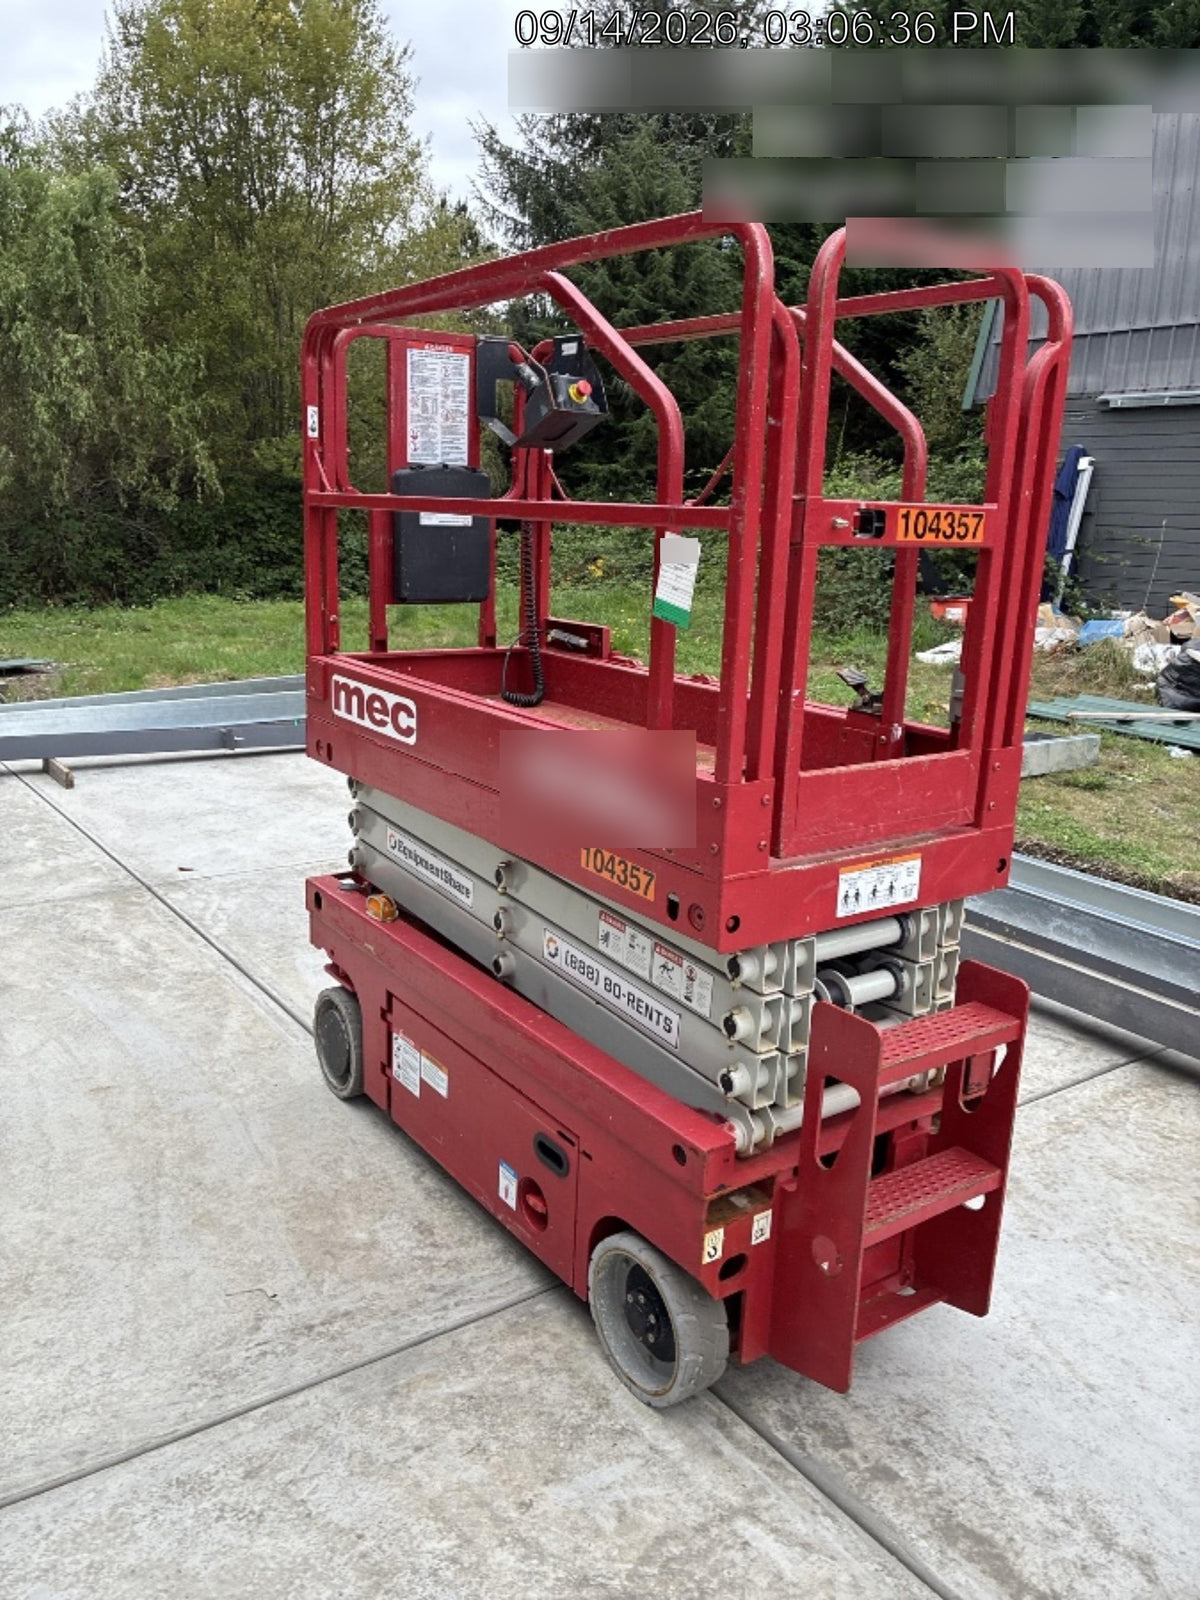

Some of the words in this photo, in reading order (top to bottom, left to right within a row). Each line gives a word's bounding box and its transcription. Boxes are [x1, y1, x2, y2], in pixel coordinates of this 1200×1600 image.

[901, 510, 984, 540] 104357
[333, 680, 415, 738] mec
[397, 838, 471, 899] EquipmentShare
[583, 848, 655, 896] 104357
[564, 949, 600, 986] (888)
[603, 976, 674, 1034] 80-RENTS
